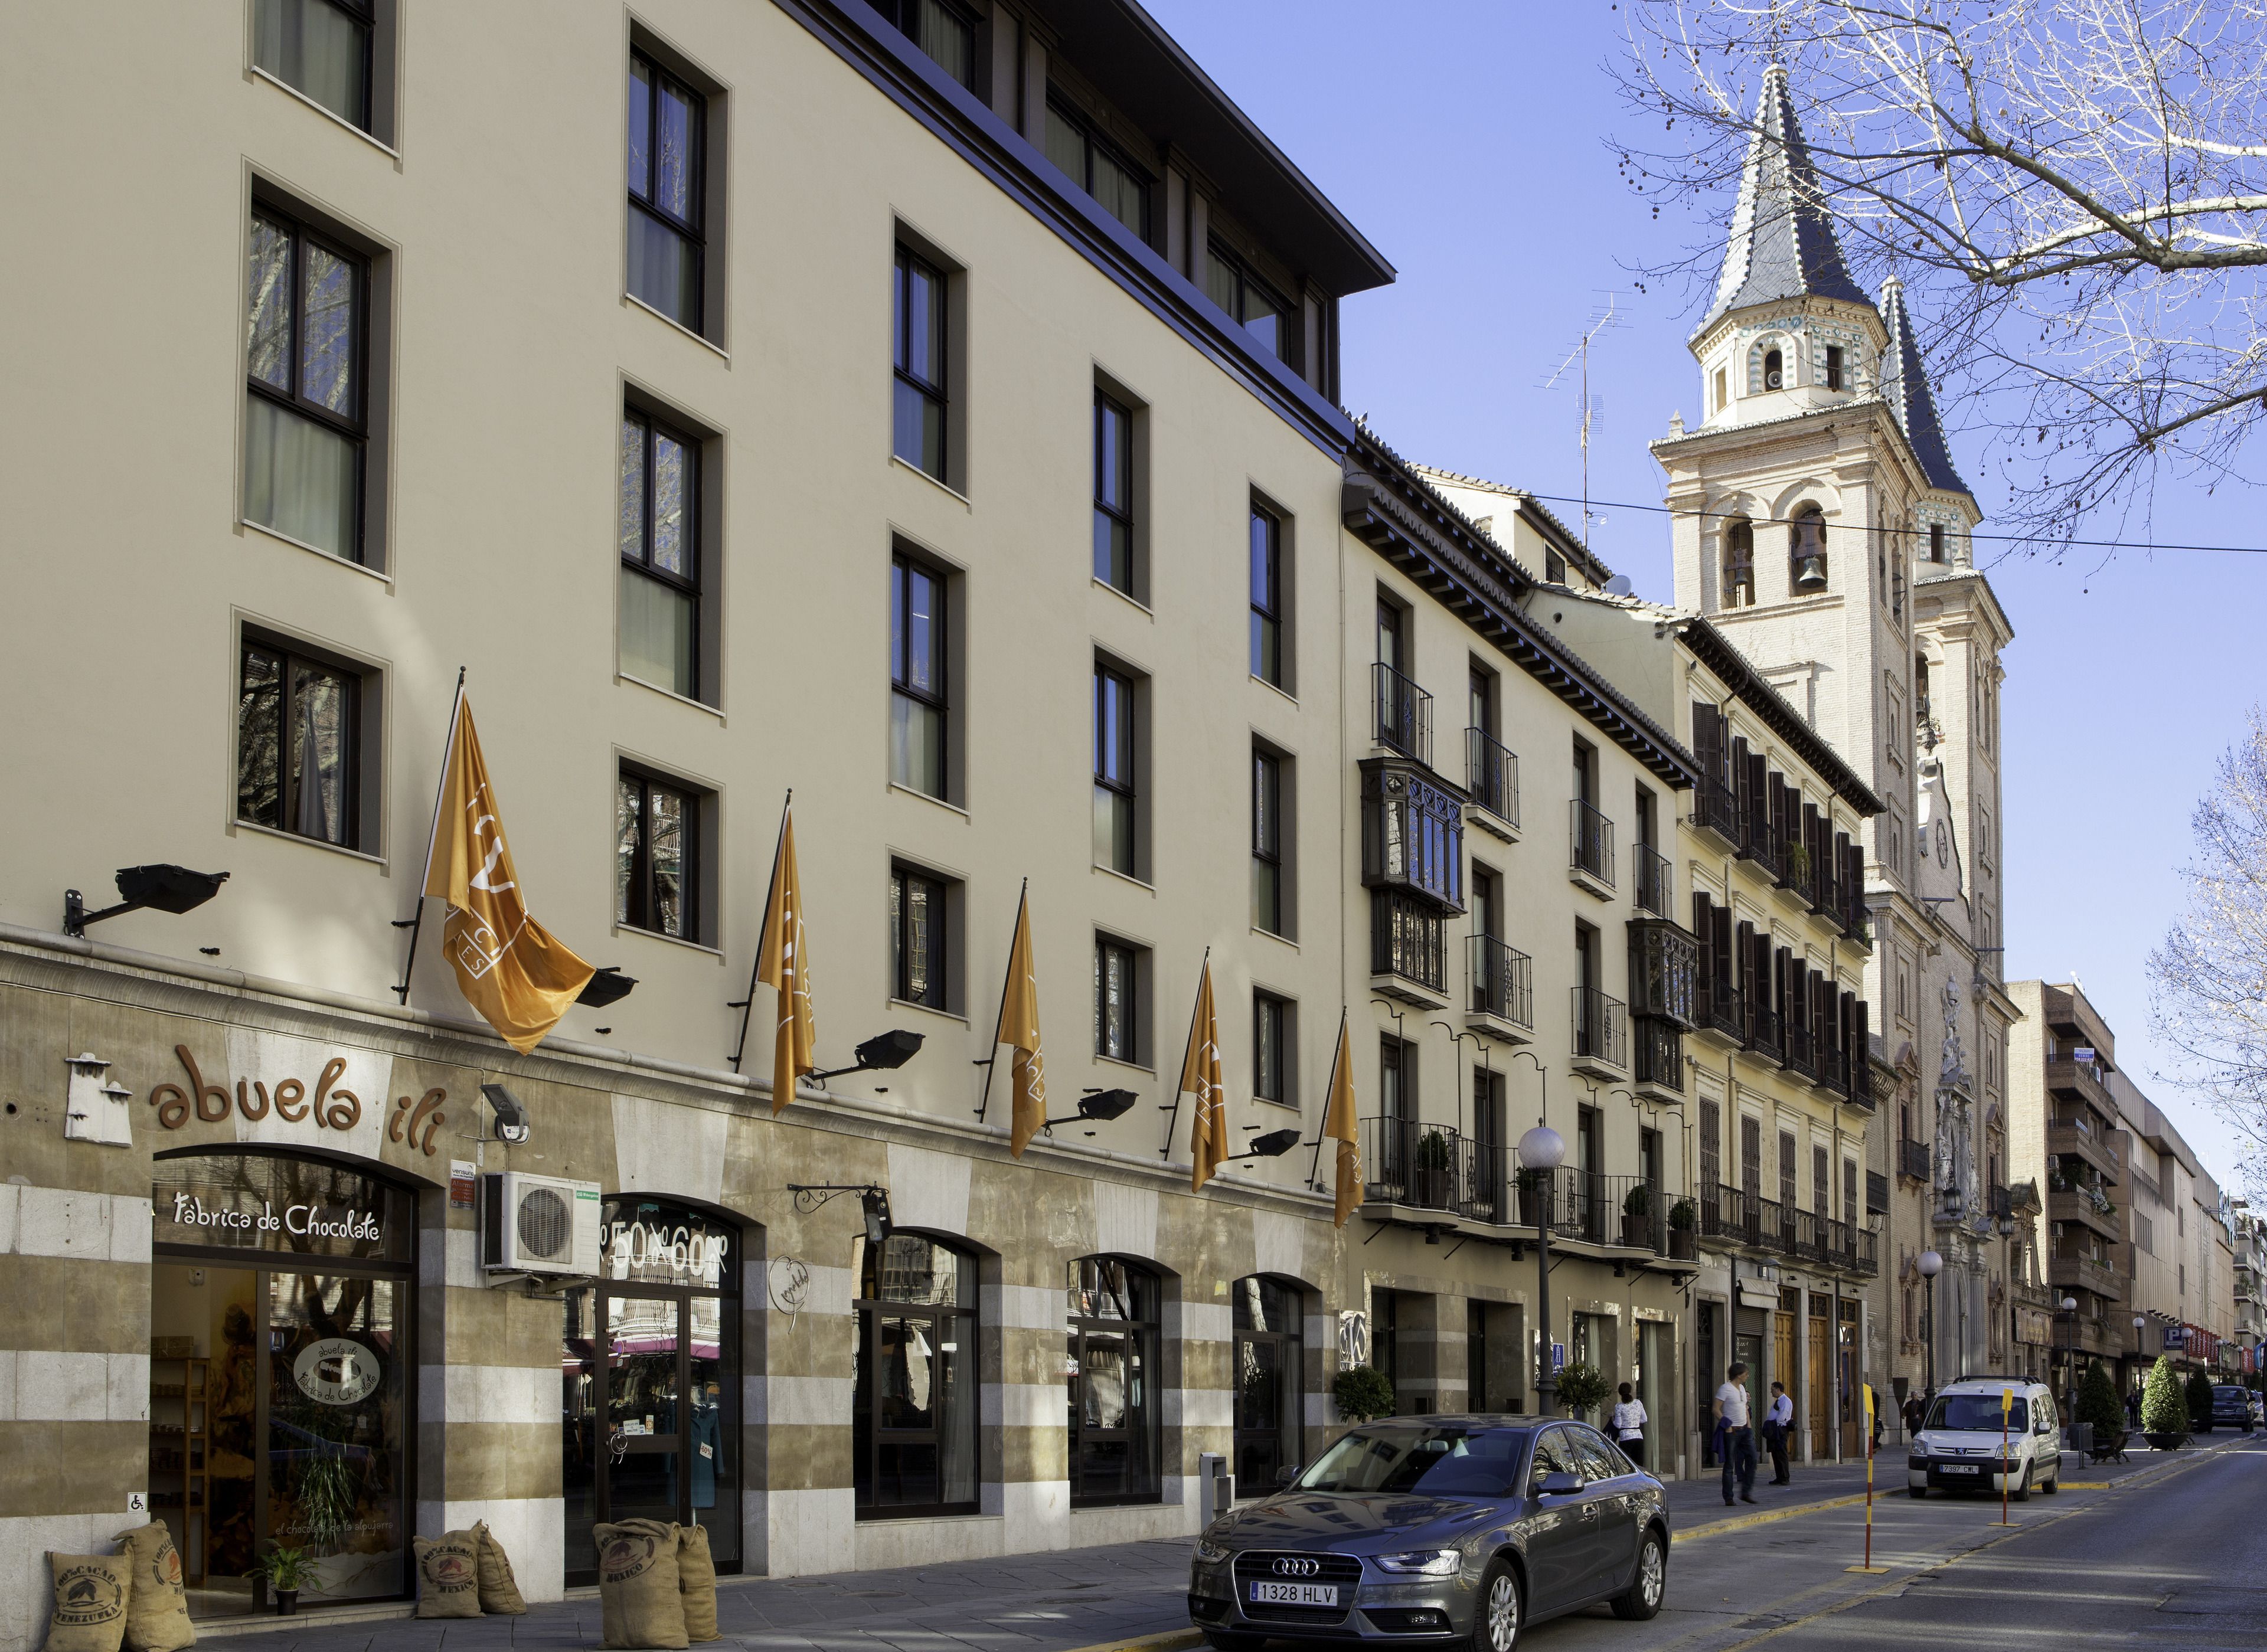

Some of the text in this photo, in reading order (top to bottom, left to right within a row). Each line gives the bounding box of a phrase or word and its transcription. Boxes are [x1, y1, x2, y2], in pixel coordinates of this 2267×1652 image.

[150, 1044, 446, 1156] abuela ili
[257, 1202, 280, 1232] de
[285, 1205, 380, 1241] Chocolate
[2168, 1330, 2180, 1340] P
[318, 1343, 345, 1357] abuela
[325, 1388, 335, 1401] de
[338, 1373, 377, 1401] Chocolate
[276, 1523, 284, 1535] el
[286, 1520, 326, 1534] chocolate
[344, 1520, 352, 1532] la
[355, 1519, 393, 1537] alpujarra
[1262, 1585, 1298, 1601] 1328
[1304, 1586, 1332, 1603] HLV
[55, 1606, 119, 1623] VENEZUELA
